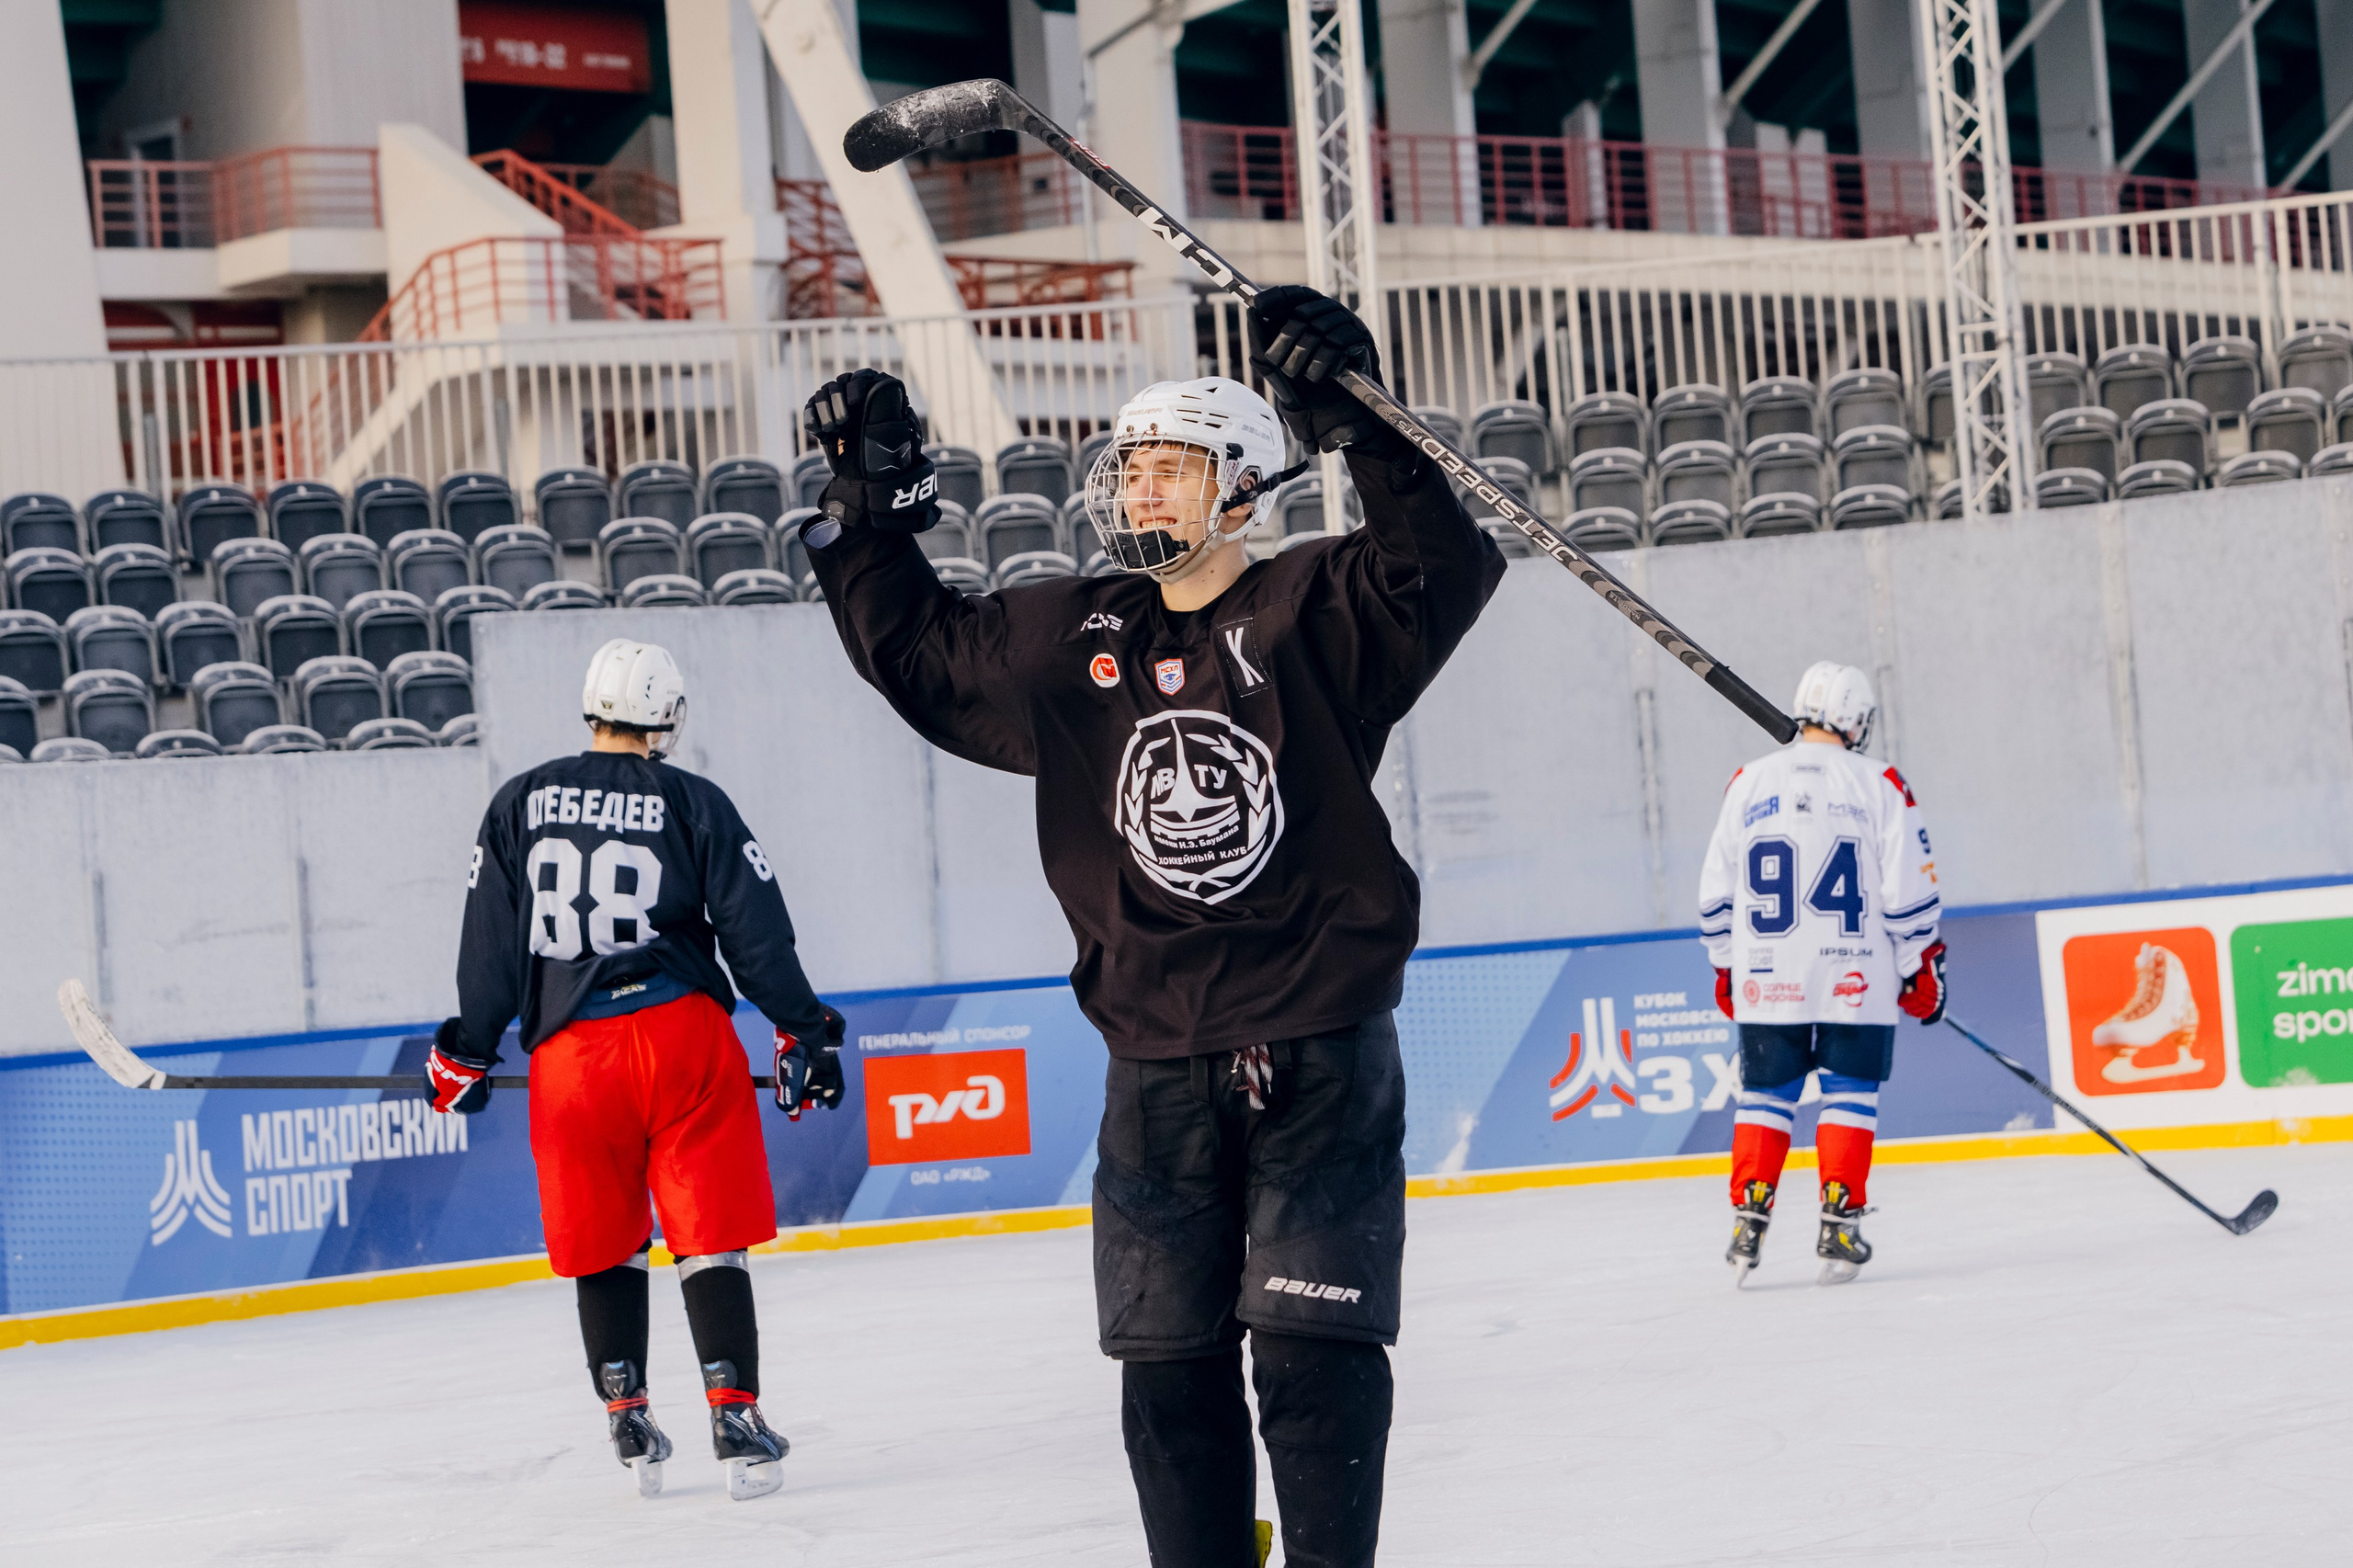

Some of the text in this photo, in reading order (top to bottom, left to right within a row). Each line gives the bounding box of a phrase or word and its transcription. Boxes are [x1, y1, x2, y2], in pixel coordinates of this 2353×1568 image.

[1421, 437, 1577, 562] JETSPEED
[1224, 627, 1265, 687] К
[1194, 764, 1228, 790] ТУ
[1199, 824, 1240, 847] Баумана
[1158, 846, 1248, 866] ХОККЕЙНЫЙ КЛУБ
[527, 837, 664, 961] 88
[1745, 834, 1869, 938] 94
[1819, 947, 1873, 957] IPSUM
[2276, 961, 2353, 997] zim
[1633, 992, 1688, 1009] КУБОК
[858, 1025, 1032, 1051] ГЕНЕРАЛЬНЫЙ СПОНСОР
[1637, 1028, 1730, 1048] ПО ХОККЕЮ
[911, 1169, 940, 1185] ОАО
[245, 1168, 352, 1236] СПОРТ
[1264, 1276, 1362, 1304] BAUER
